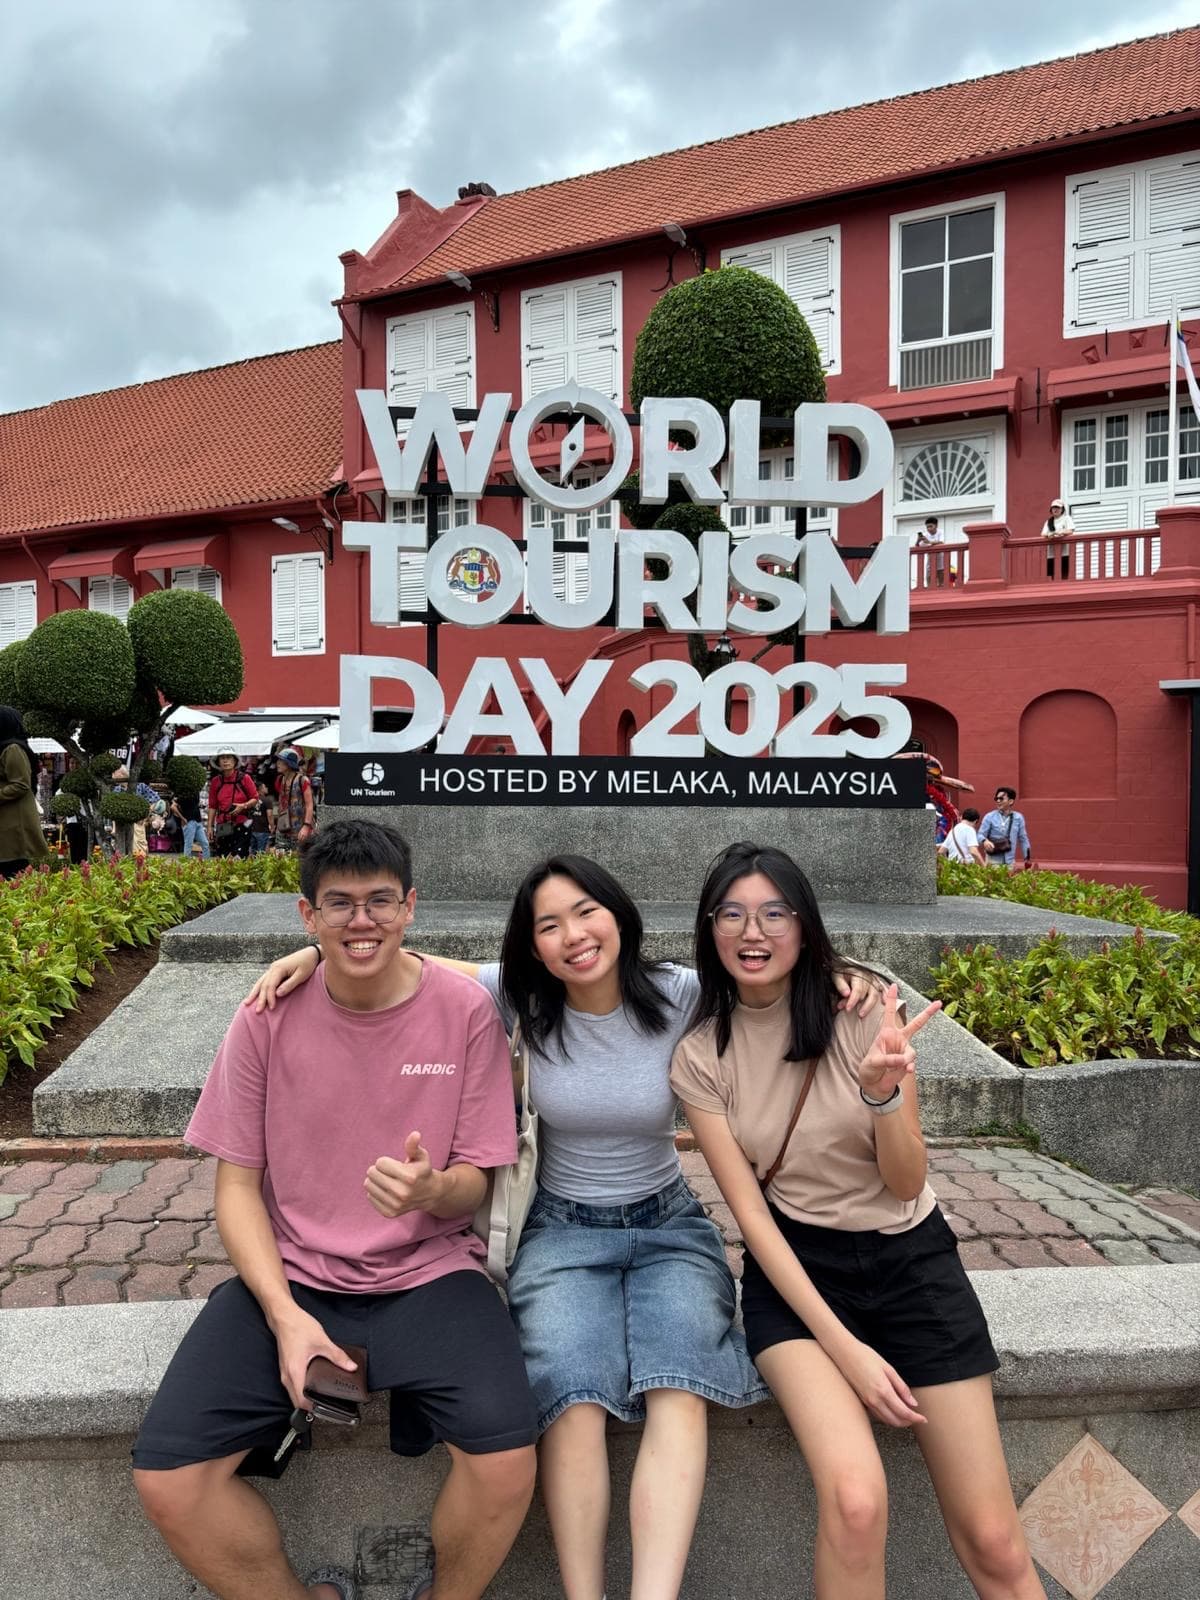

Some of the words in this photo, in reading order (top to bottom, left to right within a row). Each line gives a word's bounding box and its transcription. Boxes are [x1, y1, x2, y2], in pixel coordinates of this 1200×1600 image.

[356, 379, 894, 510] WORLD
[342, 521, 911, 634] TOURISM
[339, 655, 612, 757] DAY
[630, 661, 913, 759] 2025
[350, 788, 363, 796] UN
[364, 788, 396, 797] Tourism
[420, 768, 547, 793] HOSTED
[558, 770, 598, 793] BY
[607, 770, 737, 798] MELAKA,
[748, 771, 898, 795] MALAYSIA
